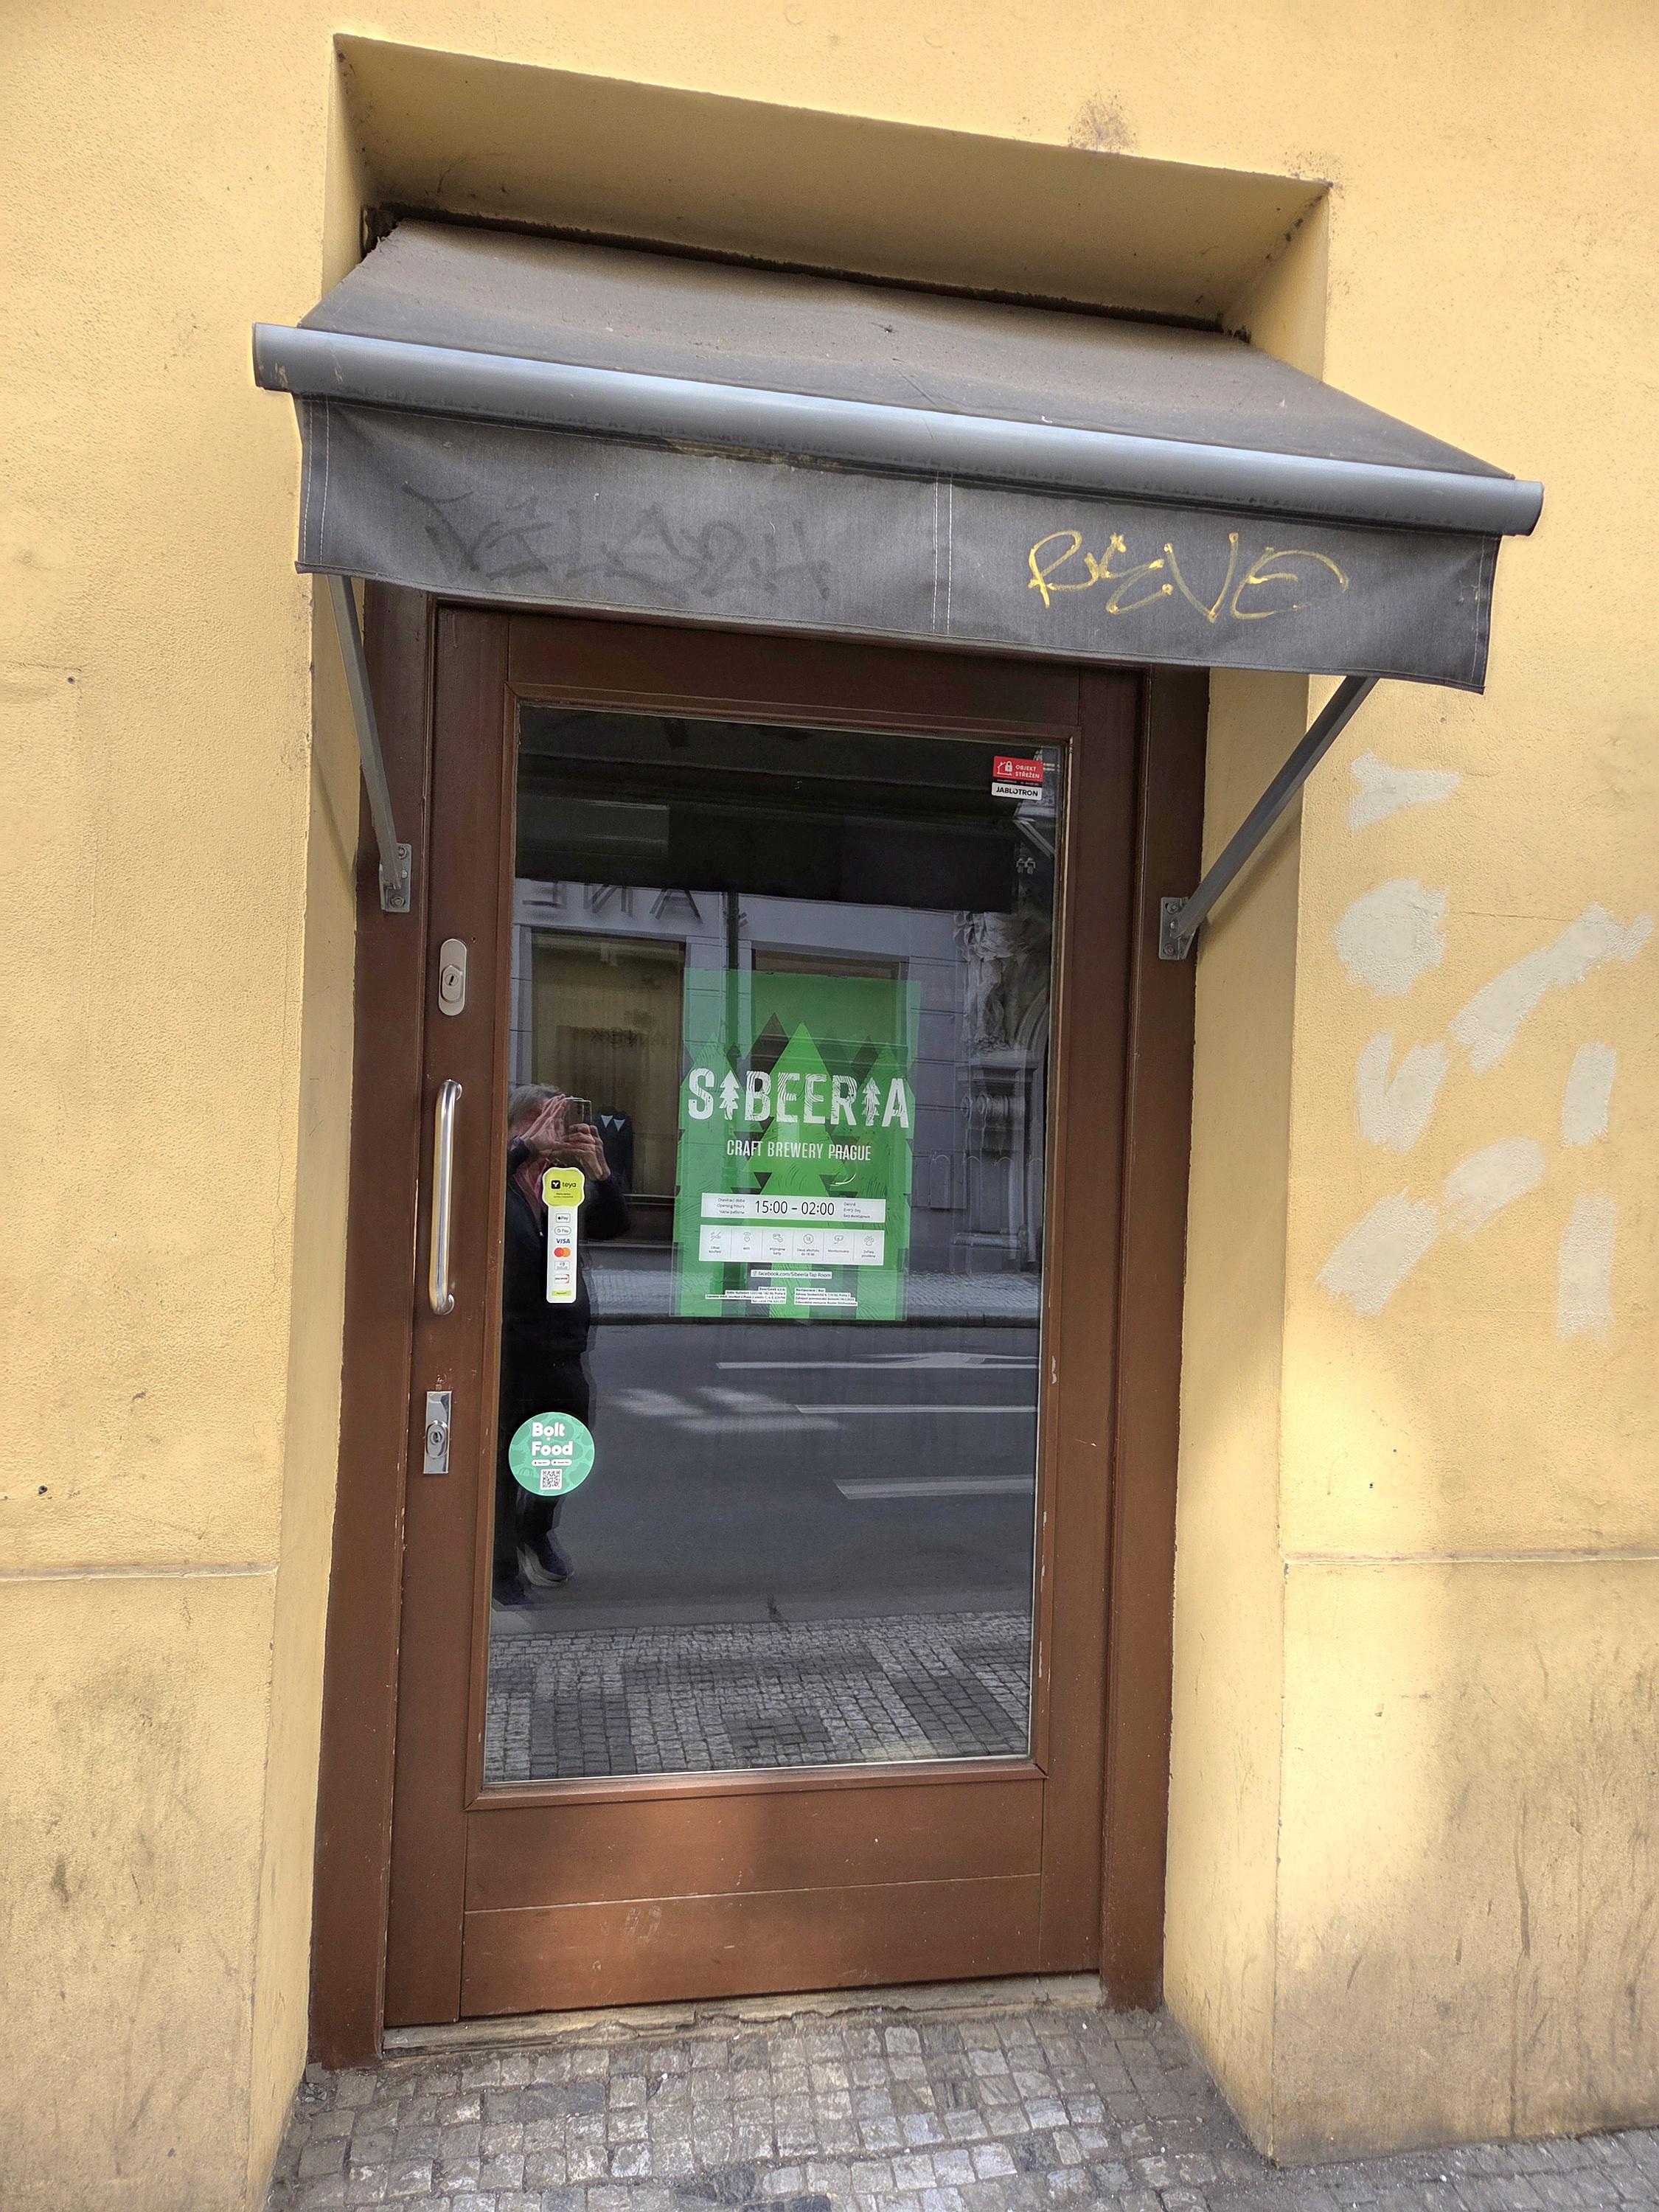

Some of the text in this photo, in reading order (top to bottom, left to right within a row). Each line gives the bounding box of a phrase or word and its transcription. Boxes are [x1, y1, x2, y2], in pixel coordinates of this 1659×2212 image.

[1015, 771, 1040, 779] STŘEŽEN
[995, 786, 1038, 797] JABLOTRON
[726, 1139, 872, 1161] CRAFT BREWERY PRAGUE
[563, 1181, 577, 1191] teya
[755, 1200, 788, 1214] 15:00
[801, 1201, 835, 1216] 02:00
[532, 1422, 566, 1437] Bolt
[532, 1440, 574, 1456] Food
